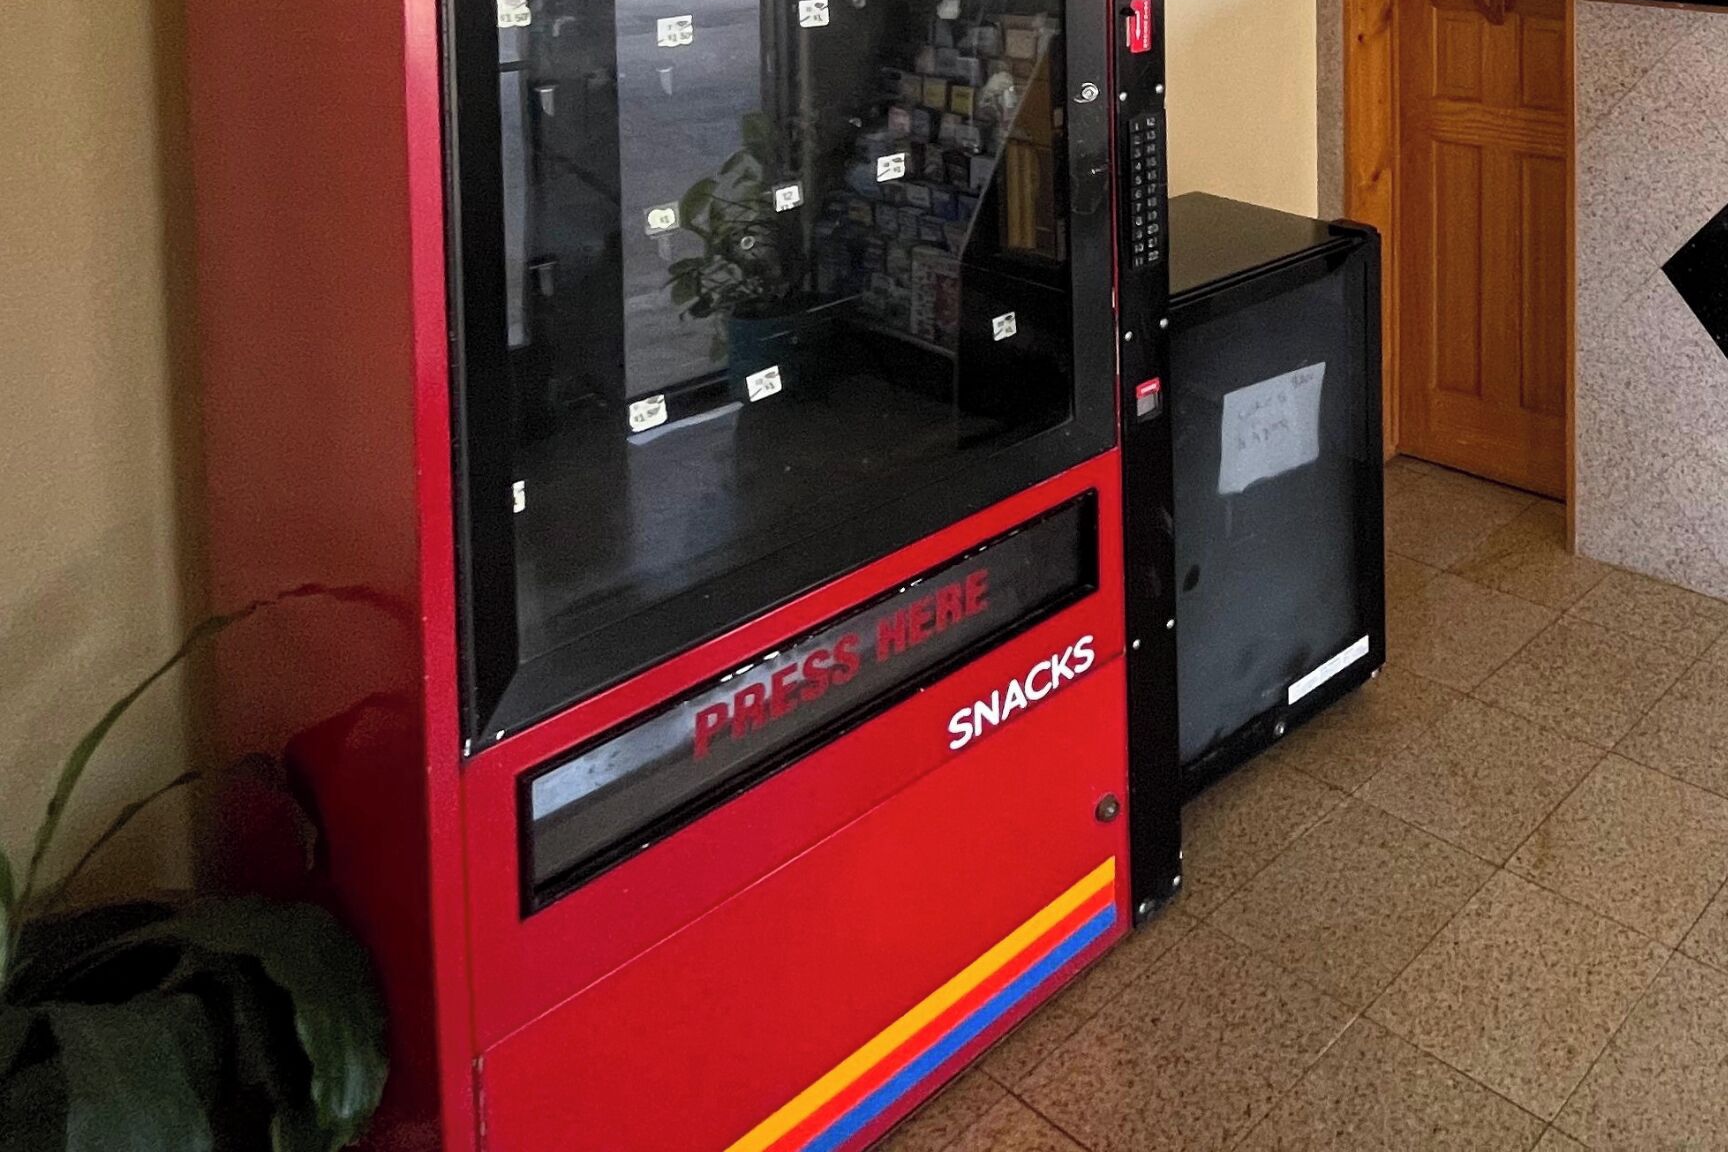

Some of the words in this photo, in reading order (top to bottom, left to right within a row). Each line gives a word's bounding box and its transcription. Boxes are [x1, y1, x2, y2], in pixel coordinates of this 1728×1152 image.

[692, 632, 863, 760] PRESS
[875, 569, 988, 660] HERE
[947, 634, 1095, 751] SNACKS
